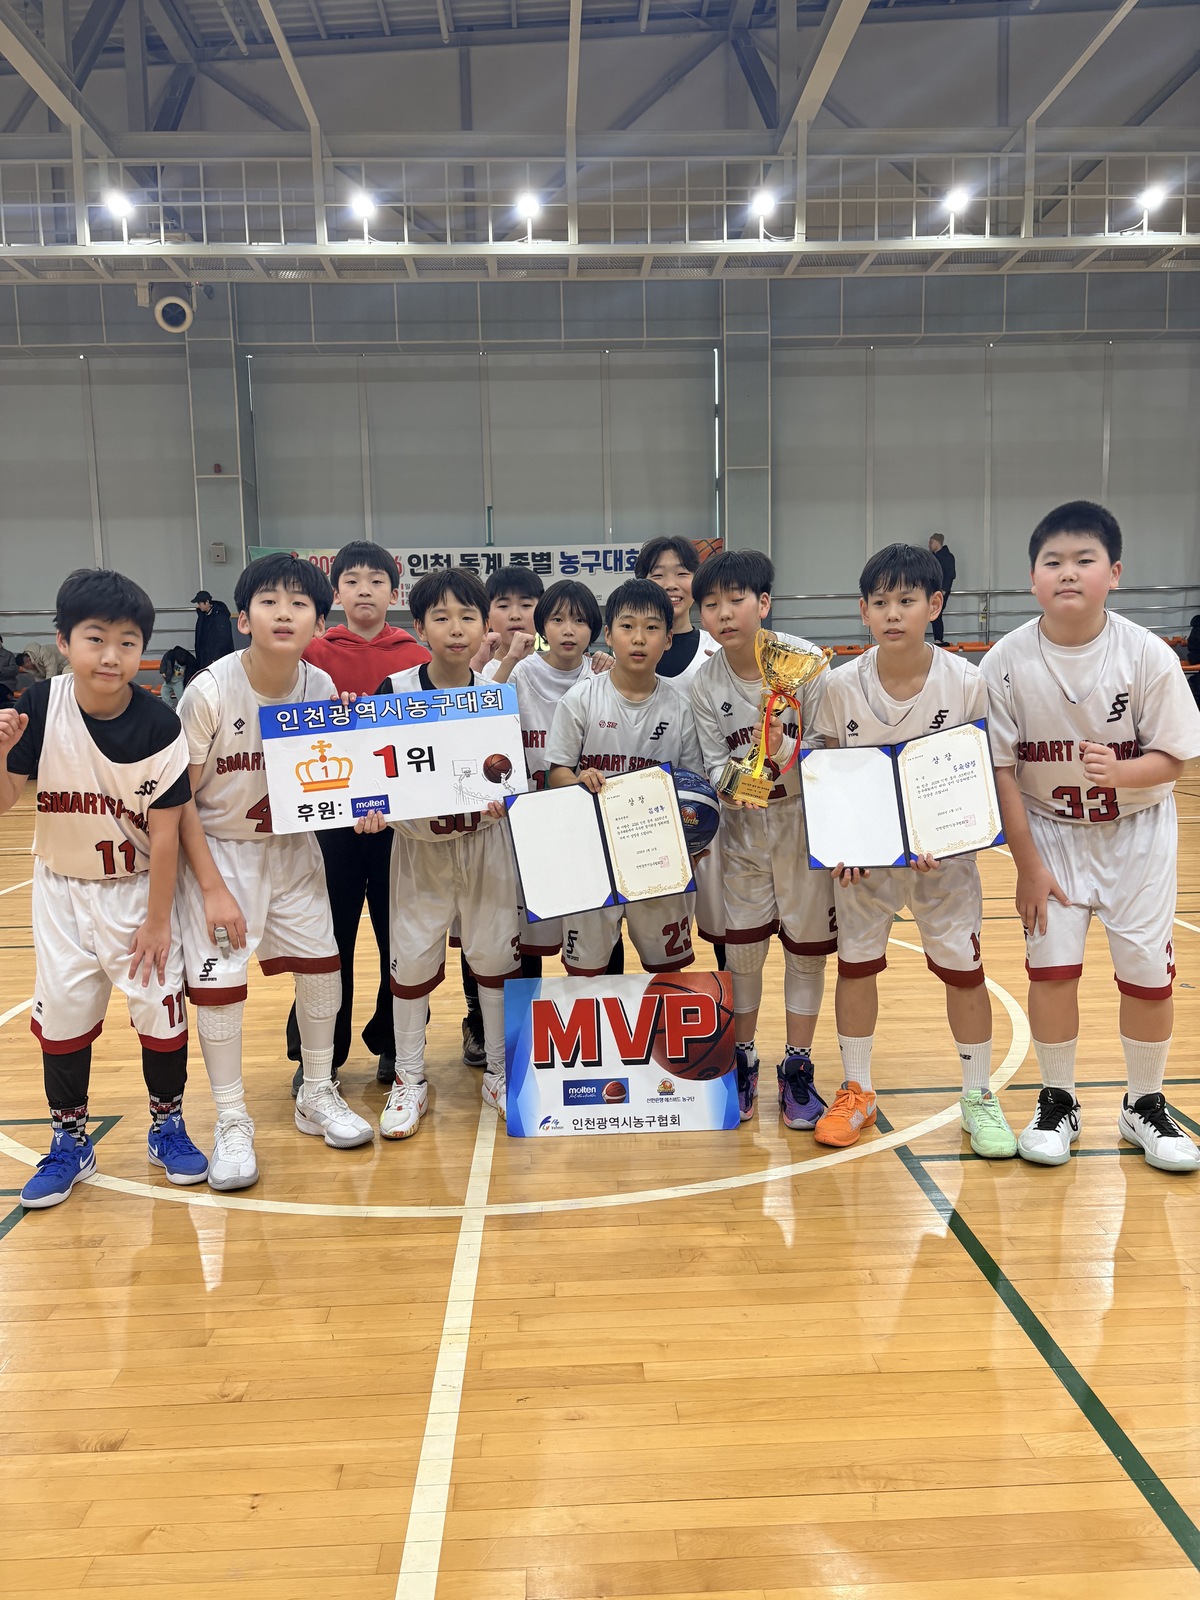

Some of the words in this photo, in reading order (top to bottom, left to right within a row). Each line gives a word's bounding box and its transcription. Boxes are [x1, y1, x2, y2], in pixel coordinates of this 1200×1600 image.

[407, 553, 452, 577] 인천
[459, 552, 502, 576] 동계
[509, 551, 552, 574] 종별
[559, 548, 640, 575] 농구대회
[276, 689, 503, 731] 인천광역시농구대회
[521, 730, 547, 749] ART
[321, 765, 329, 778] 1
[297, 800, 343, 822] 후원:
[355, 799, 385, 809] molten
[1051, 785, 1121, 823] 33
[94, 840, 136, 875] 11
[531, 993, 720, 1069] MVP
[568, 1086, 597, 1094] molten
[572, 1114, 681, 1131] 인천광역시농구협회
